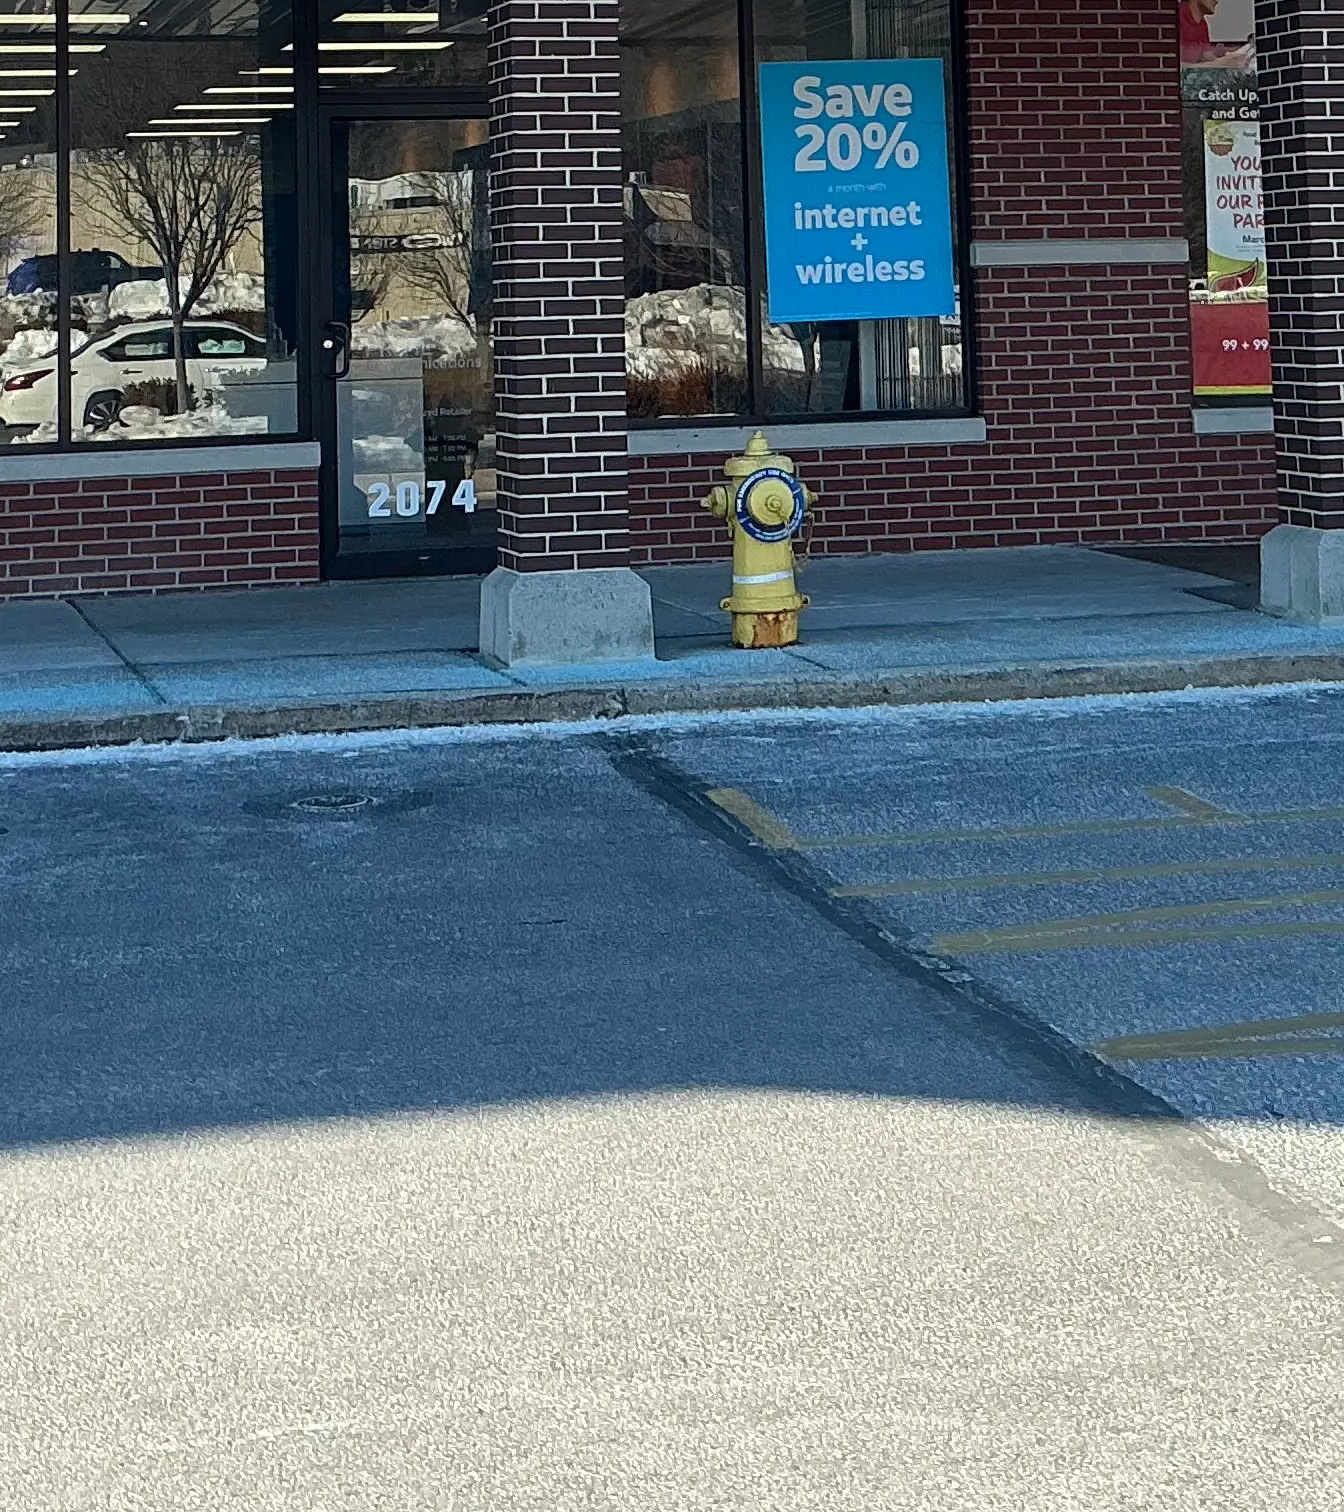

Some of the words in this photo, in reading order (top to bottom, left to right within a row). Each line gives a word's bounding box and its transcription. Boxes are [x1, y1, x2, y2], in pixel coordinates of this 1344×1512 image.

[793, 75, 913, 120] Save
[1198, 88, 1235, 101] Catch
[1211, 106, 1236, 119] and
[794, 121, 920, 173] 20%
[1216, 174, 1263, 191] INVIT
[1216, 193, 1254, 210] OUR
[794, 201, 922, 230] internet
[1232, 213, 1265, 229] PAR
[1242, 234, 1265, 244] Marc
[795, 254, 926, 285] wireless
[1221, 338, 1238, 352] 99
[1252, 337, 1269, 352] 99
[422, 355, 483, 370] nications
[367, 478, 478, 519] 2074
